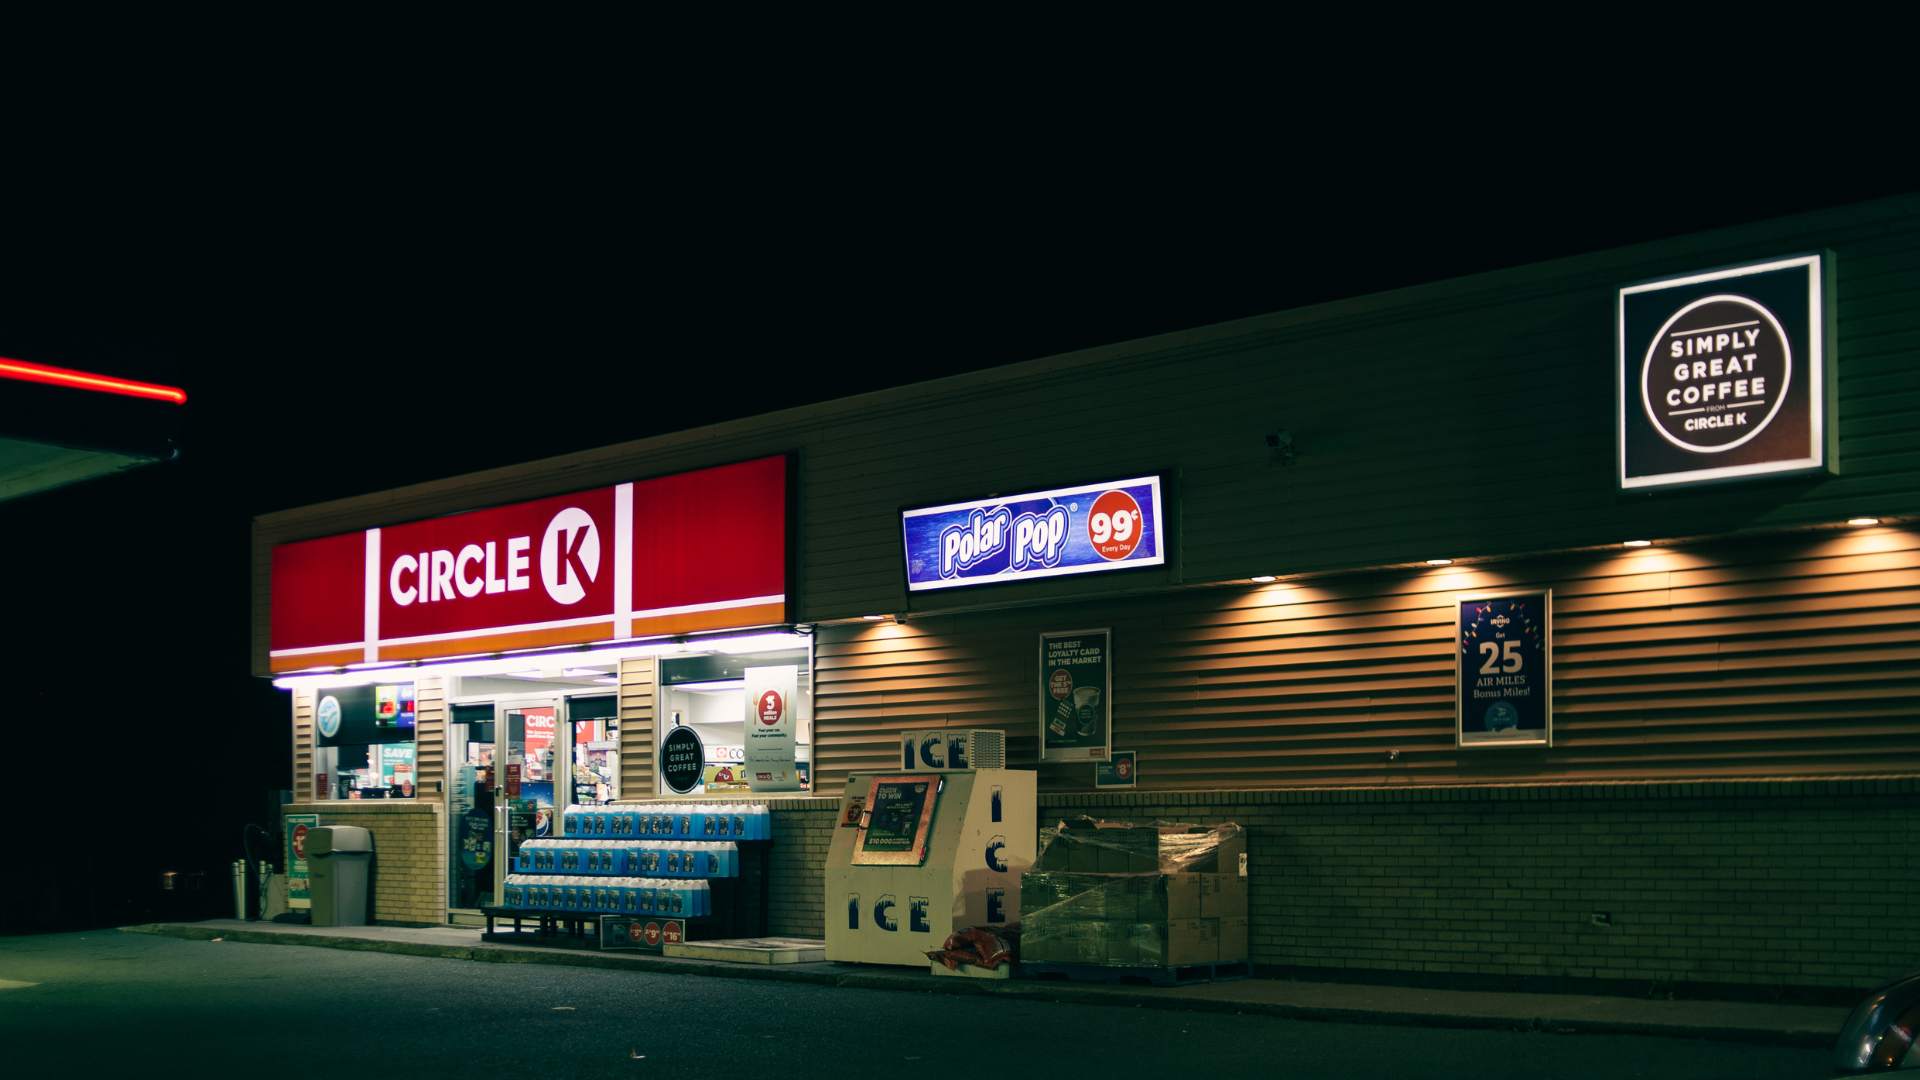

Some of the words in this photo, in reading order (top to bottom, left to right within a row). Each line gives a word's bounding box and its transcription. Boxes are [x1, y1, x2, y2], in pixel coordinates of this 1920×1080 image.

[1670, 328, 1761, 359] SIMPLY
[1674, 353, 1758, 382] GREAT
[1666, 376, 1766, 407] COFFEE
[1706, 404, 1726, 413] FROM
[1684, 413, 1734, 431] CIRCLE
[1736, 411, 1747, 425] K
[943, 511, 1008, 573] Polar
[1013, 509, 1066, 567] Pop
[1101, 545, 1118, 553] Every
[1119, 543, 1131, 551] Day
[389, 535, 531, 607] CIRCLE
[553, 520, 598, 600] K
[1049, 642, 1062, 650] THE
[1063, 640, 1080, 649] BEST
[1049, 649, 1078, 659] LOYALTY
[1080, 648, 1100, 656] CARD
[1479, 639, 1524, 675] 25
[1049, 658, 1056, 668] IN
[1057, 658, 1071, 666] THE
[1072, 655, 1102, 665] MARKET
[1476, 676, 1494, 687] AIR
[1495, 674, 1527, 686] MILES
[1473, 688, 1502, 699] Bonus
[1503, 685, 1531, 697] Miles!
[383, 747, 413, 759] SAVE
[668, 742, 695, 752] SIMPLY
[904, 731, 969, 769] ICE
[669, 753, 694, 762] GREAT
[667, 763, 697, 773] COFFEE
[985, 784, 1009, 923] ICE
[848, 892, 930, 933] ICE
